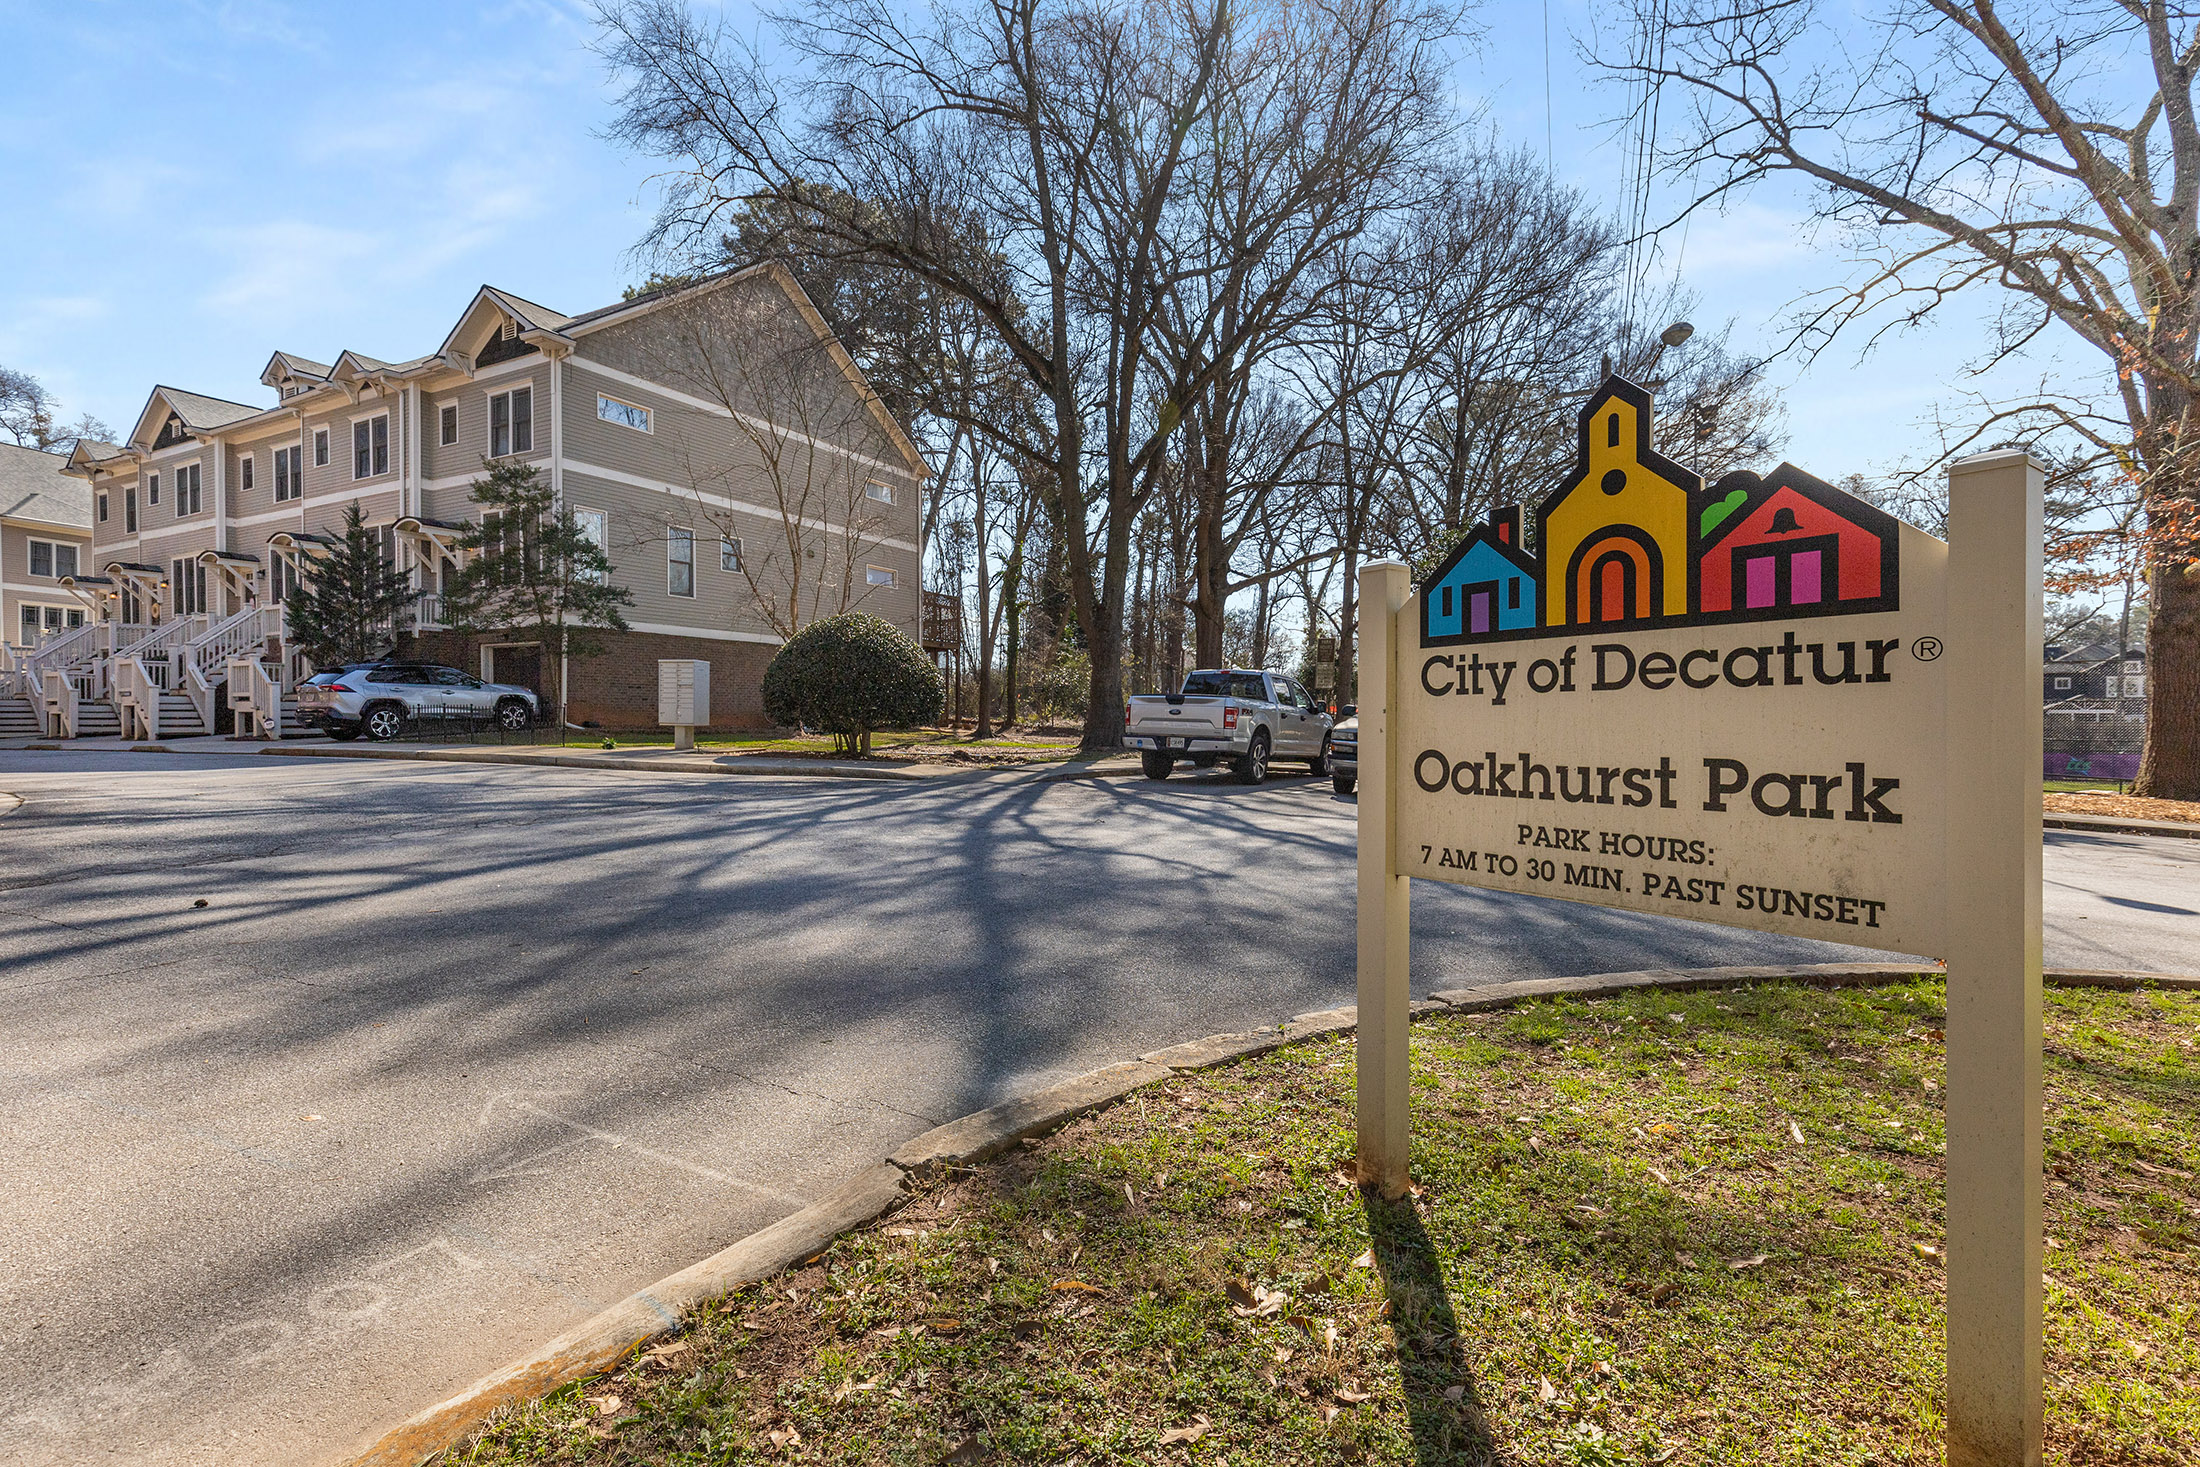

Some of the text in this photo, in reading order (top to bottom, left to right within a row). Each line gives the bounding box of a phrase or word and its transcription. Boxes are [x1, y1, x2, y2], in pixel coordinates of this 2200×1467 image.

[1420, 653, 1517, 706] City
[1526, 644, 1577, 694] of
[1591, 631, 1900, 692] Decatur
[1413, 749, 1903, 825] Oakhurst Park
[1517, 823, 1715, 867] PARK HOURS:
[1421, 844, 1886, 929] 7 AM TO 30 MIN. PAST SUNSET
